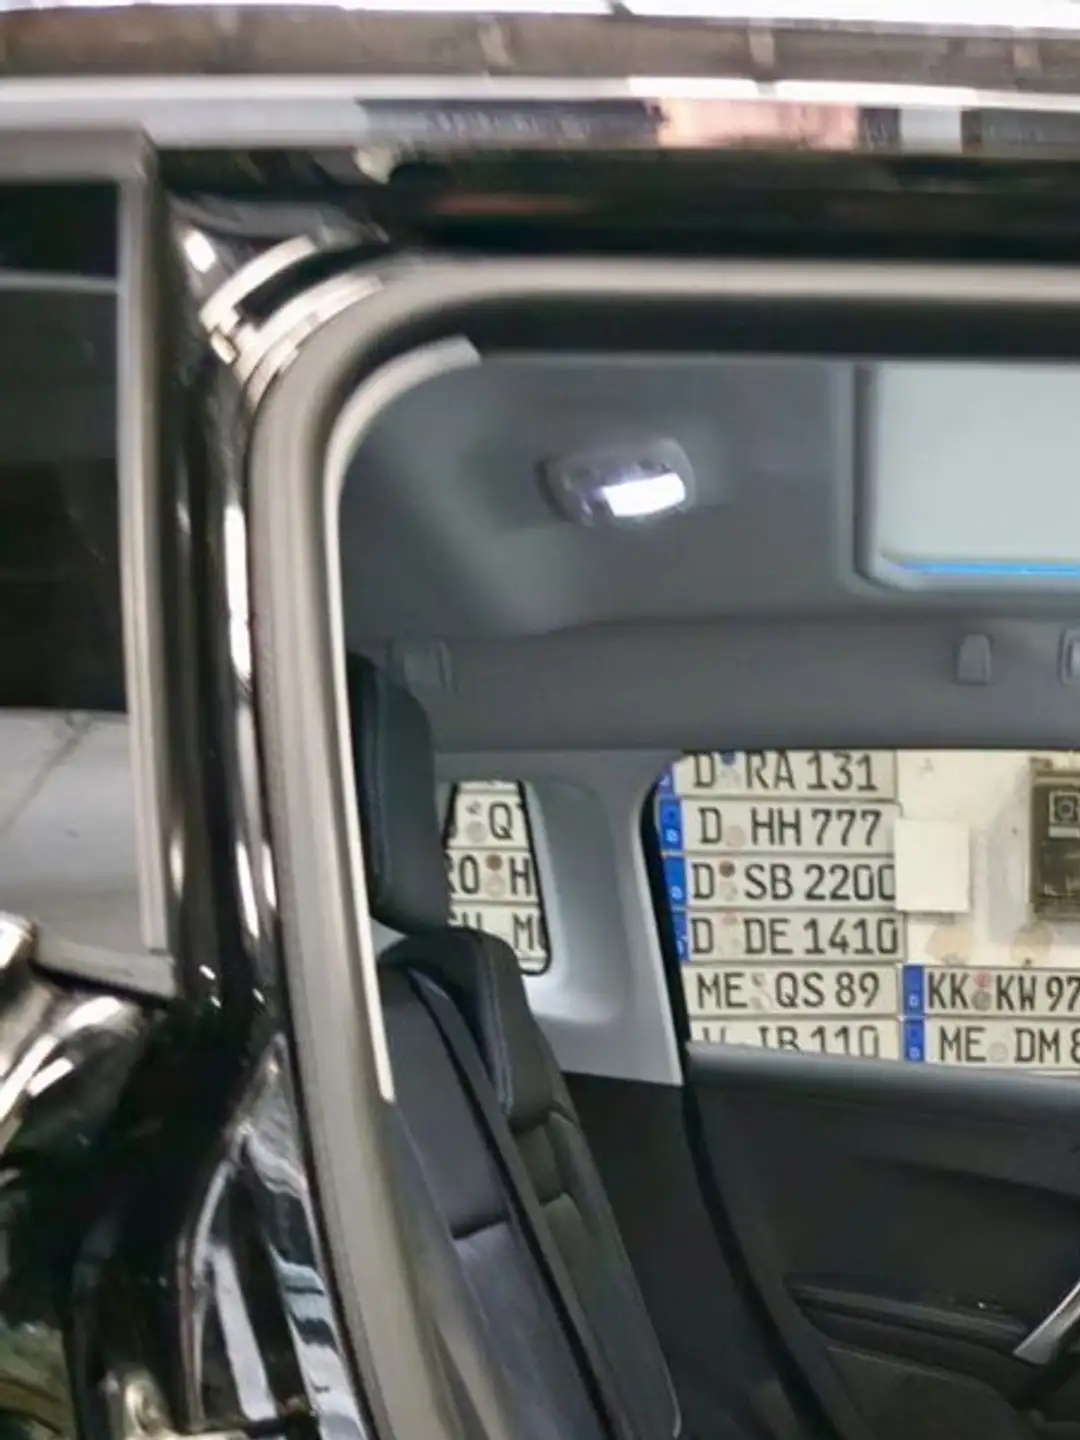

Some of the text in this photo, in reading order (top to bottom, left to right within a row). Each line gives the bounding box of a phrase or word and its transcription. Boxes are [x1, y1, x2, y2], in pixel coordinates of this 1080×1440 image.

[693, 751, 880, 792] D RA 131
[699, 807, 882, 847] D HH 777
[692, 863, 715, 901] D
[744, 863, 794, 902] SB
[691, 916, 898, 955] D DE 1410
[696, 971, 881, 1010] ME QS 89
[928, 971, 969, 1010] KK
[995, 975, 1037, 1011] KW
[939, 1026, 987, 1063] ME
[1014, 1027, 1061, 1064] DM
